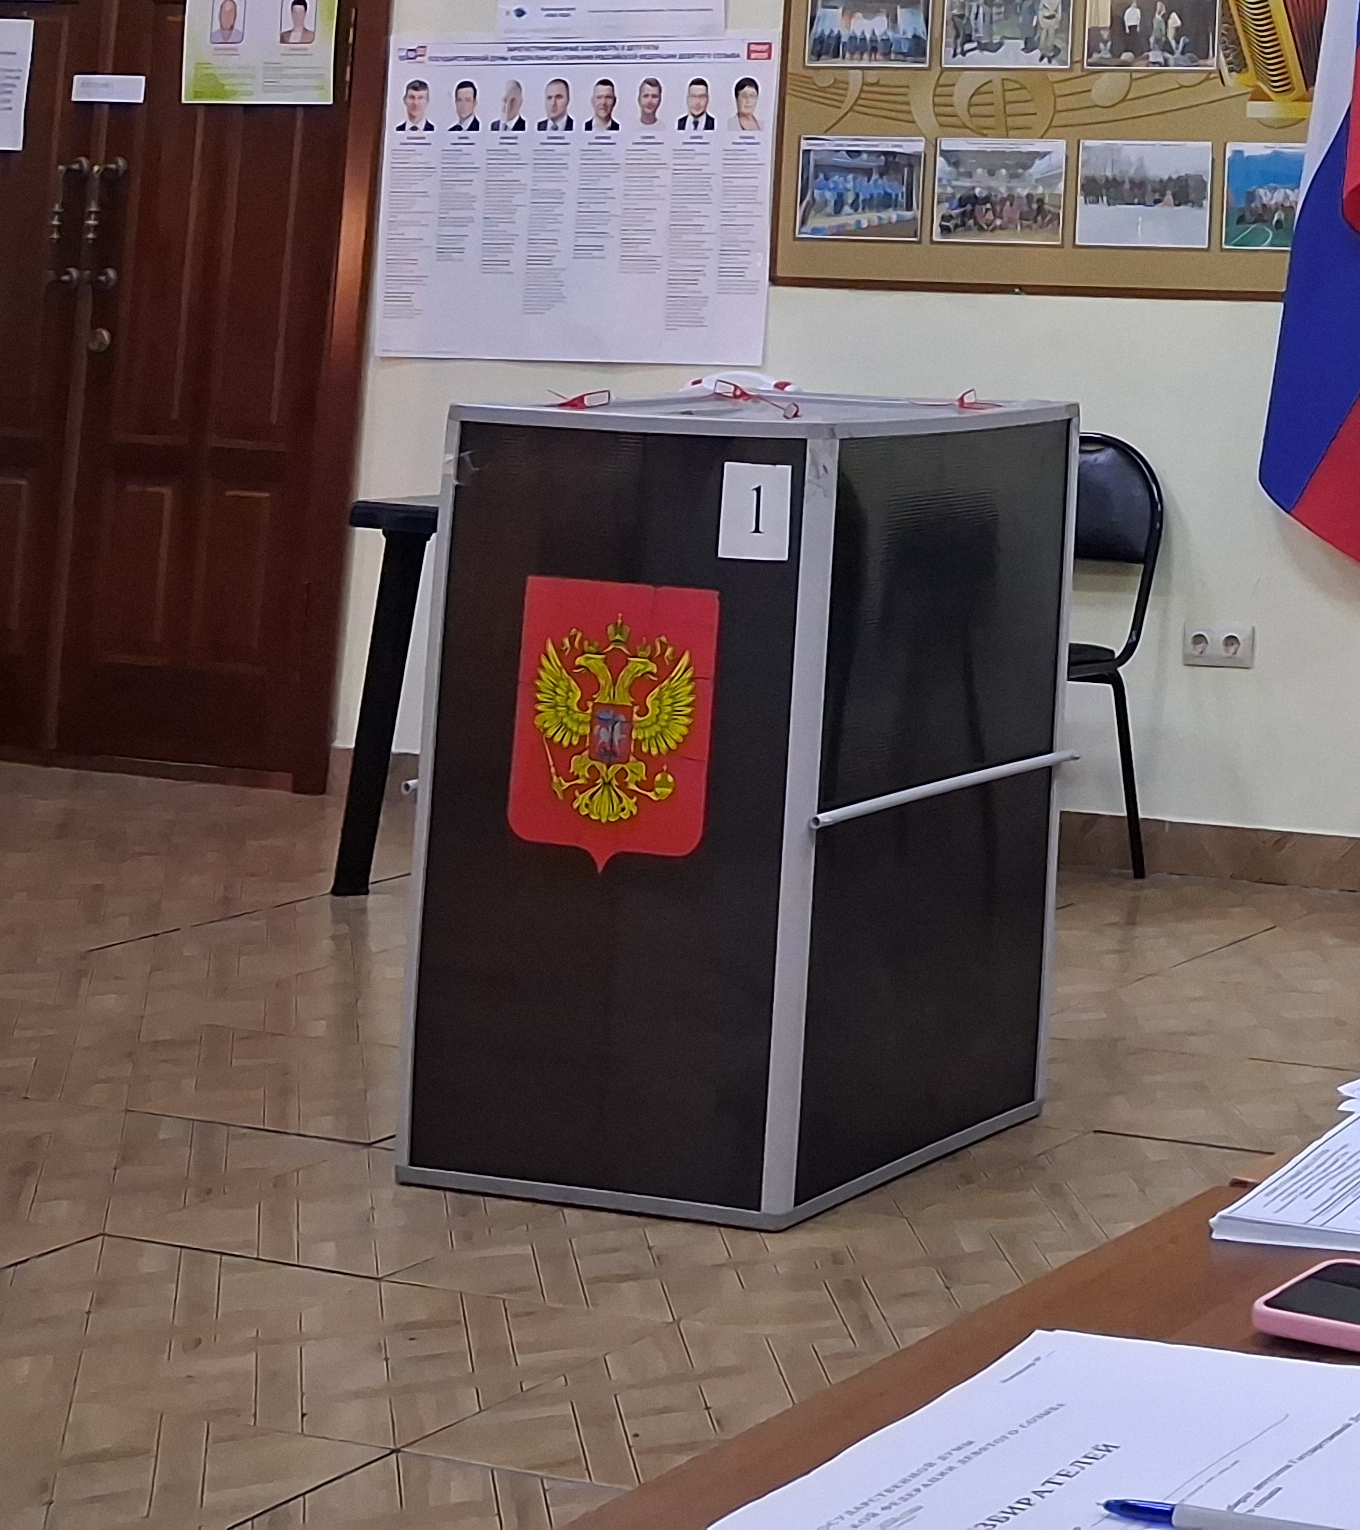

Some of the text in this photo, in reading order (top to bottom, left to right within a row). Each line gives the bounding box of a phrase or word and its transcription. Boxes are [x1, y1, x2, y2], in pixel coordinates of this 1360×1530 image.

[750, 484, 765, 535] 1
[880, 1465, 958, 1512] ФЕДЕРАЦИИ
[957, 1429, 1019, 1465] ДЕВЯТОГО
[966, 1443, 1121, 1530] ЗБИРАТЕЛЕЙ
